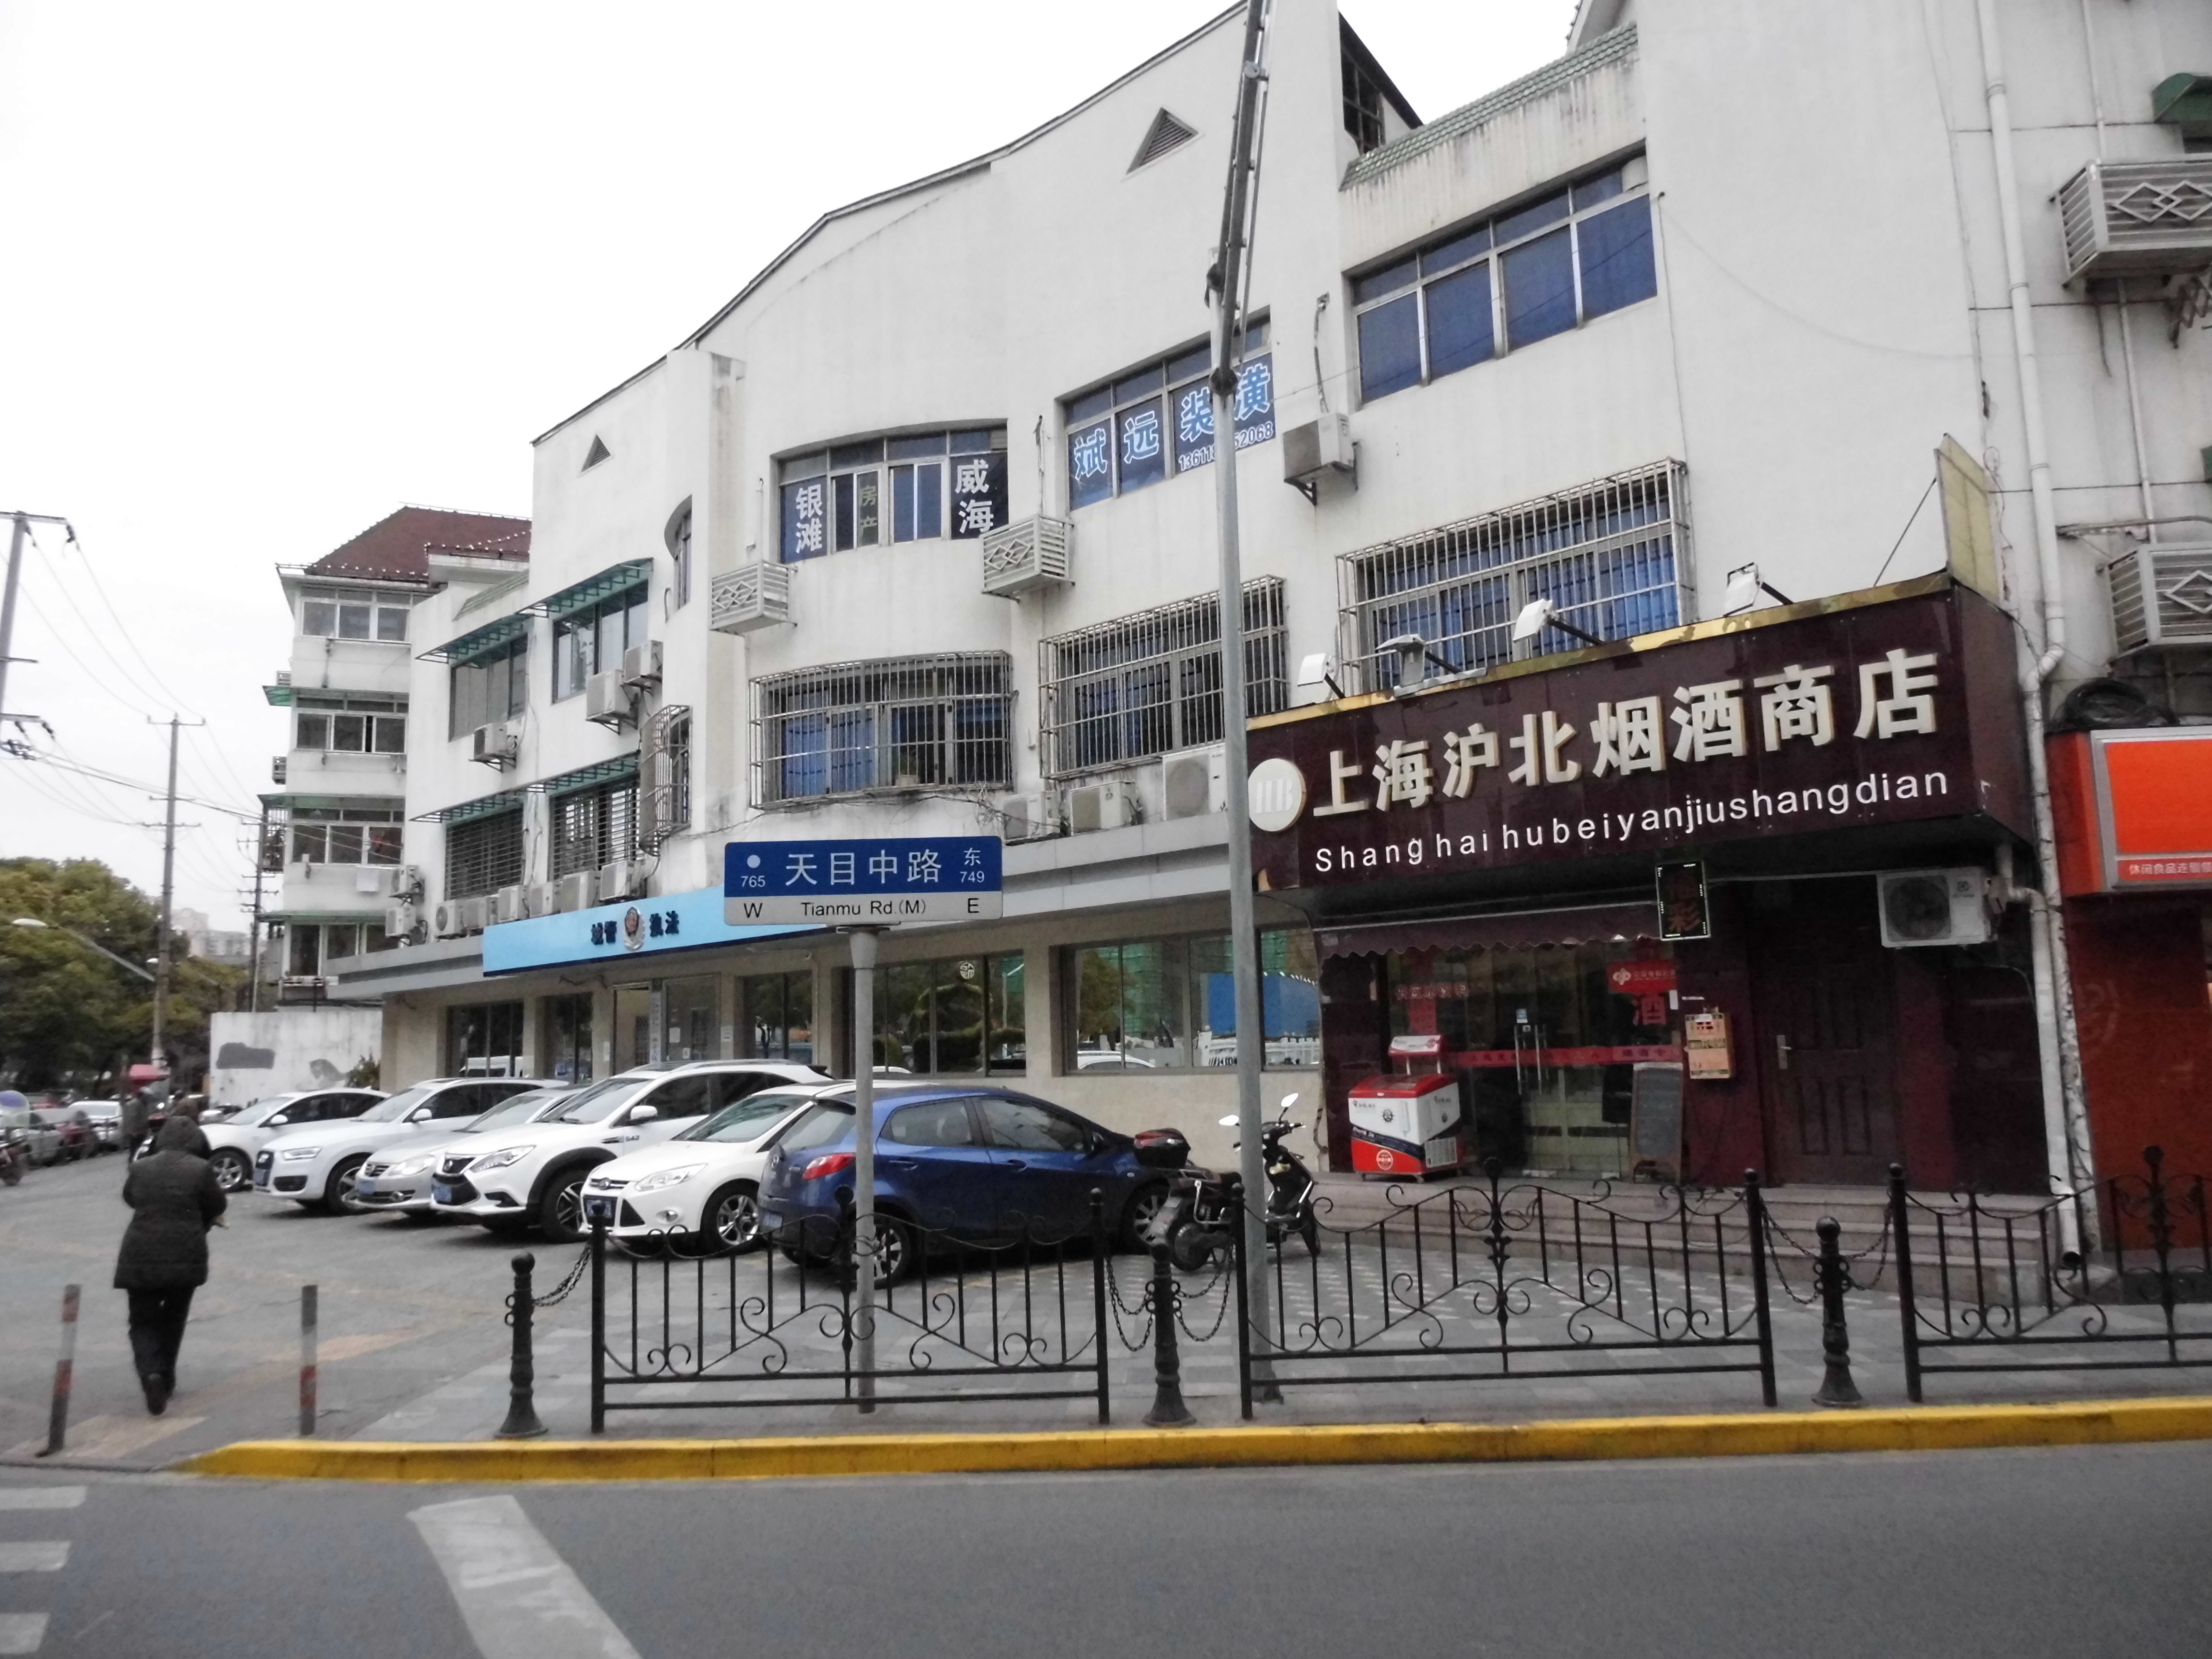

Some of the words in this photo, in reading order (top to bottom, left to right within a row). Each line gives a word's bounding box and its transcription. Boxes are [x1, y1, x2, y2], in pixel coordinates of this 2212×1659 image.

[955, 459, 994, 533] 威海
[795, 484, 823, 554] 银滩
[1313, 648, 1938, 817] 上海沪北烟酒商店
[963, 847, 981, 866] 东
[785, 849, 941, 886] 天目中路
[741, 876, 766, 888] 765
[960, 871, 985, 883] 749
[744, 902, 763, 918] W
[801, 902, 861, 916] Tianmu
[967, 898, 979, 914] E
